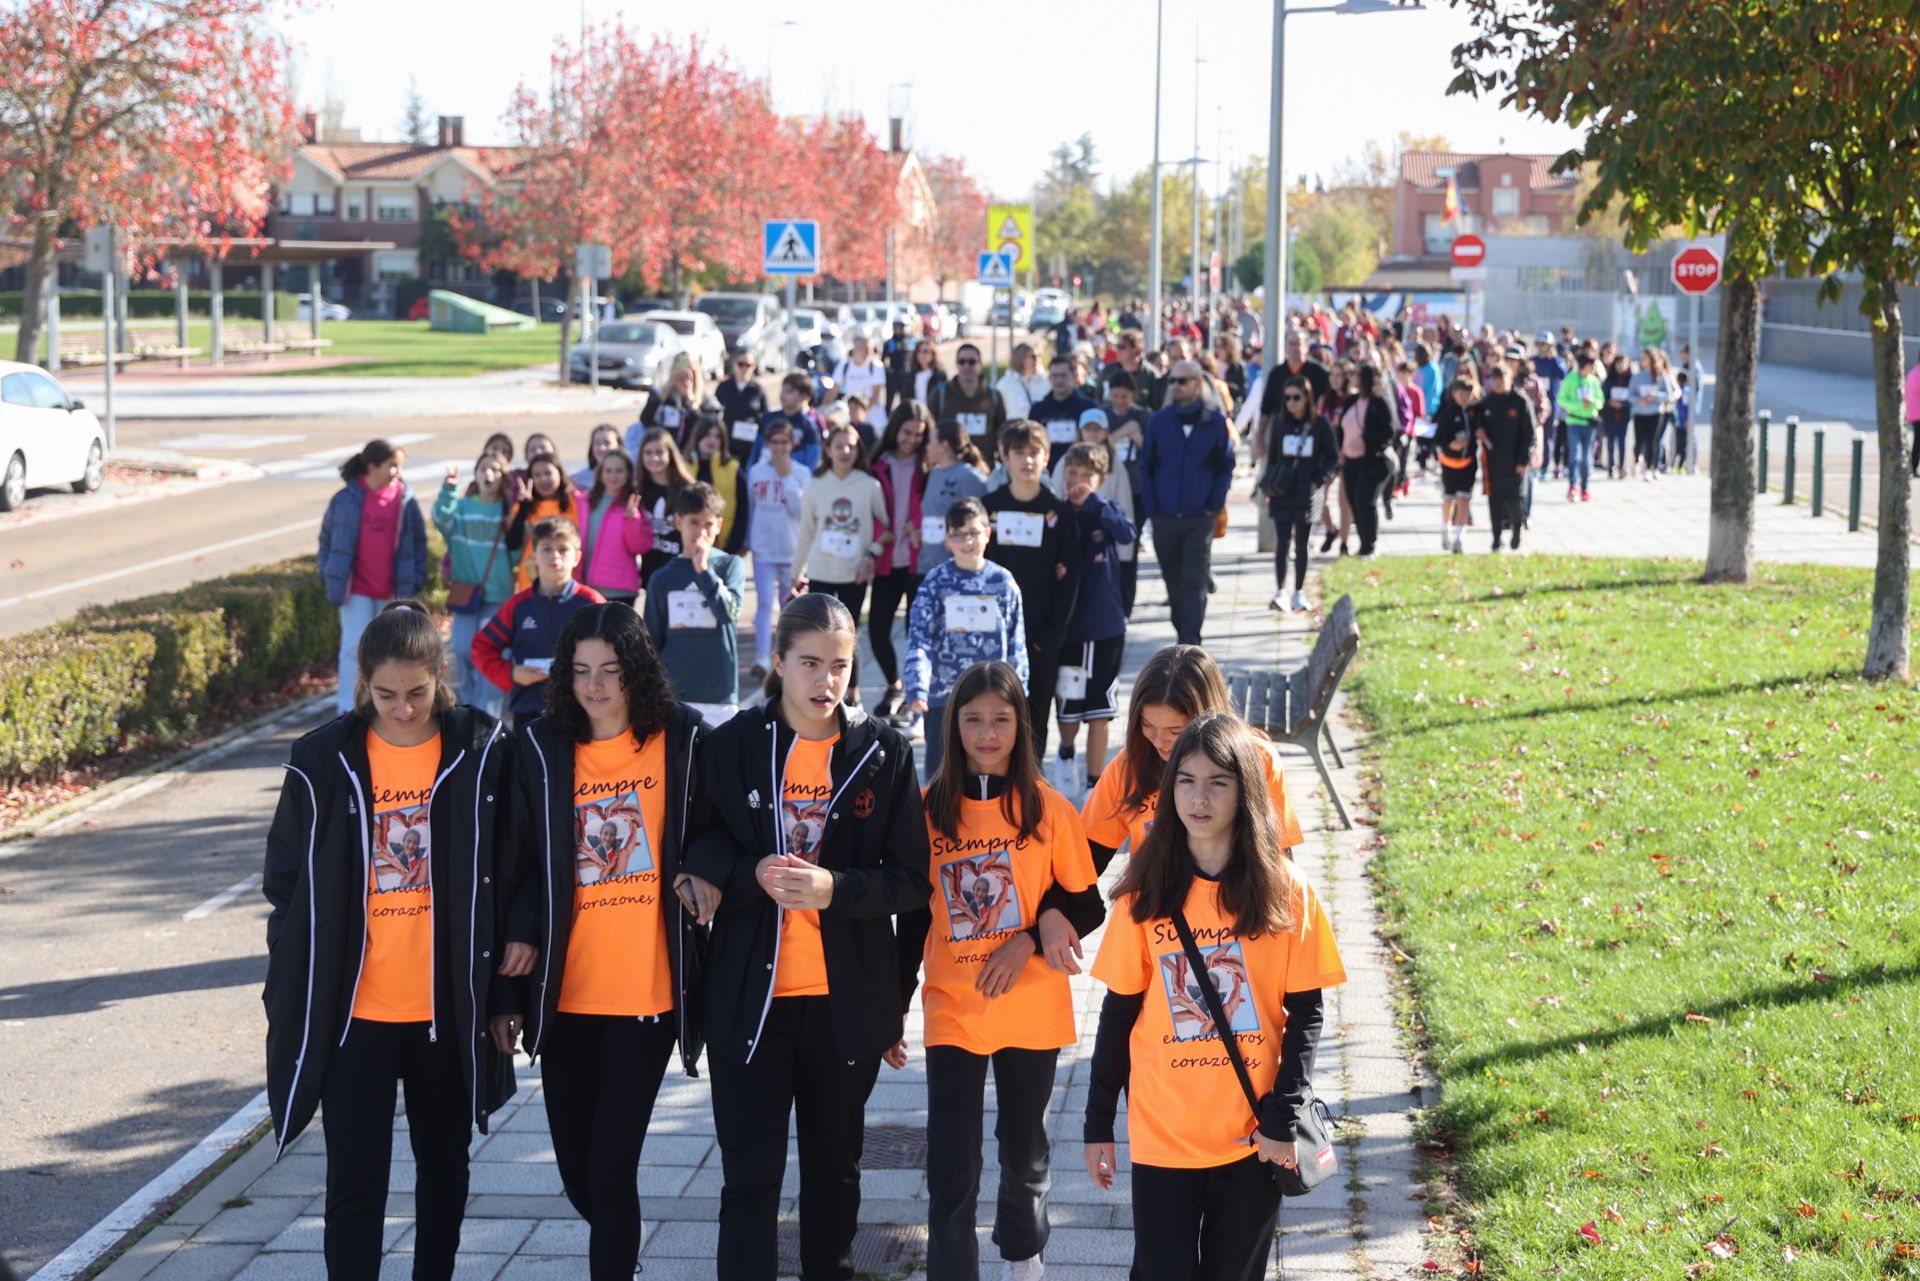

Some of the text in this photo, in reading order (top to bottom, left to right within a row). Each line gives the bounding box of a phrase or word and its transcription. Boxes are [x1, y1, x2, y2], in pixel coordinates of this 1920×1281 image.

[1677, 263, 1717, 277] STOP
[574, 776, 658, 798] empre
[372, 786, 432, 807] iemp
[933, 836, 1029, 856] Siempre
[592, 870, 661, 887] nuestros
[392, 882, 431, 895] nues
[372, 904, 432, 918] corazon
[965, 927, 1019, 943] nuestr
[1154, 921, 1261, 947] Simp
[1163, 1029, 1267, 1045] en nutros
[1171, 1055, 1262, 1070] corazoes
